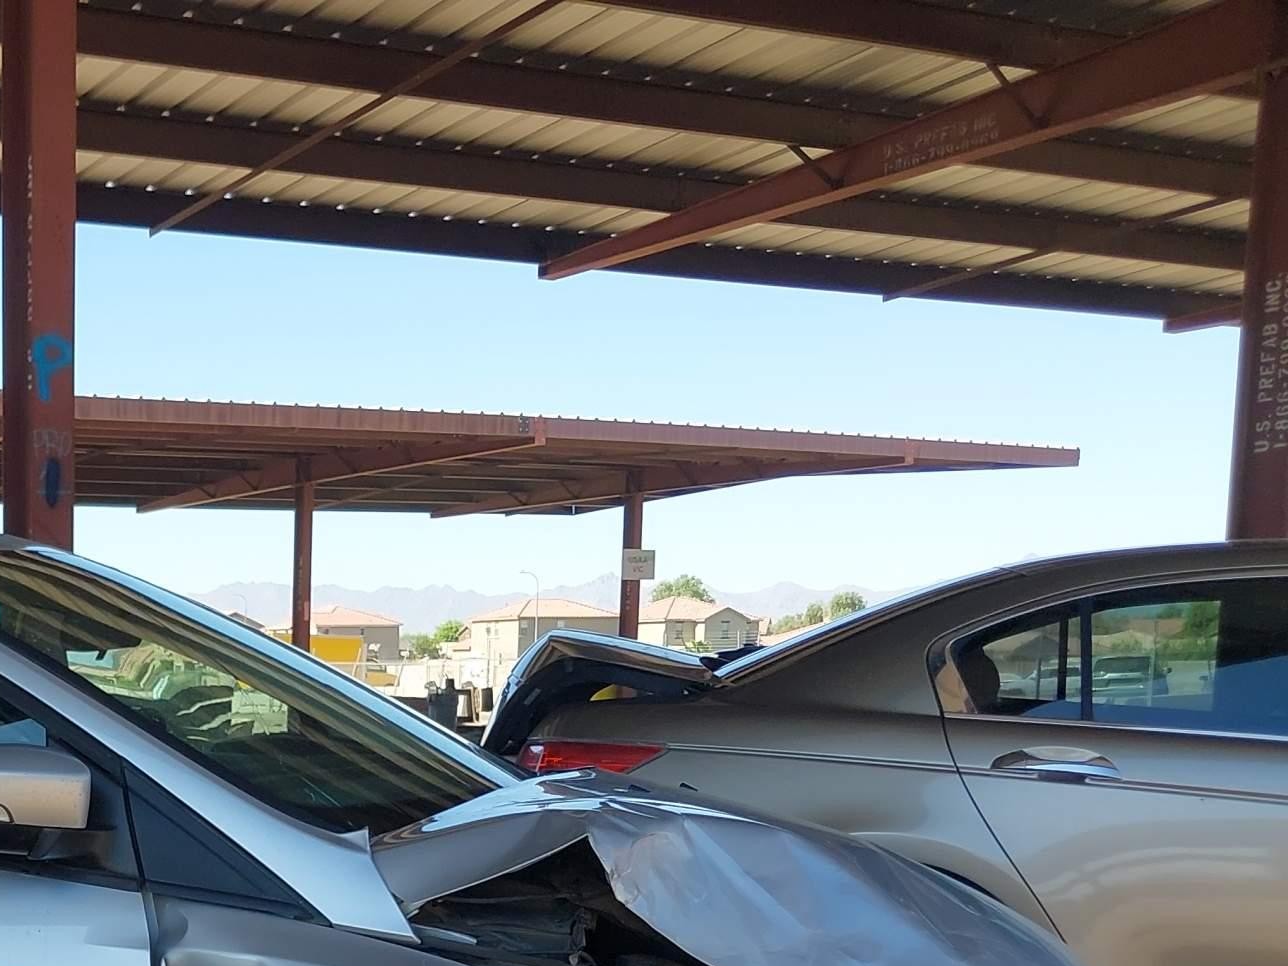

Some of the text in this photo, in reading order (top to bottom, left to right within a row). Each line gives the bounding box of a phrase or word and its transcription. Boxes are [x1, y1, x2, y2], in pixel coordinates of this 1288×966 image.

[31, 332, 73, 402] P
[1257, 323, 1279, 403] PREFAB
[1253, 413, 1273, 454] U.S.
